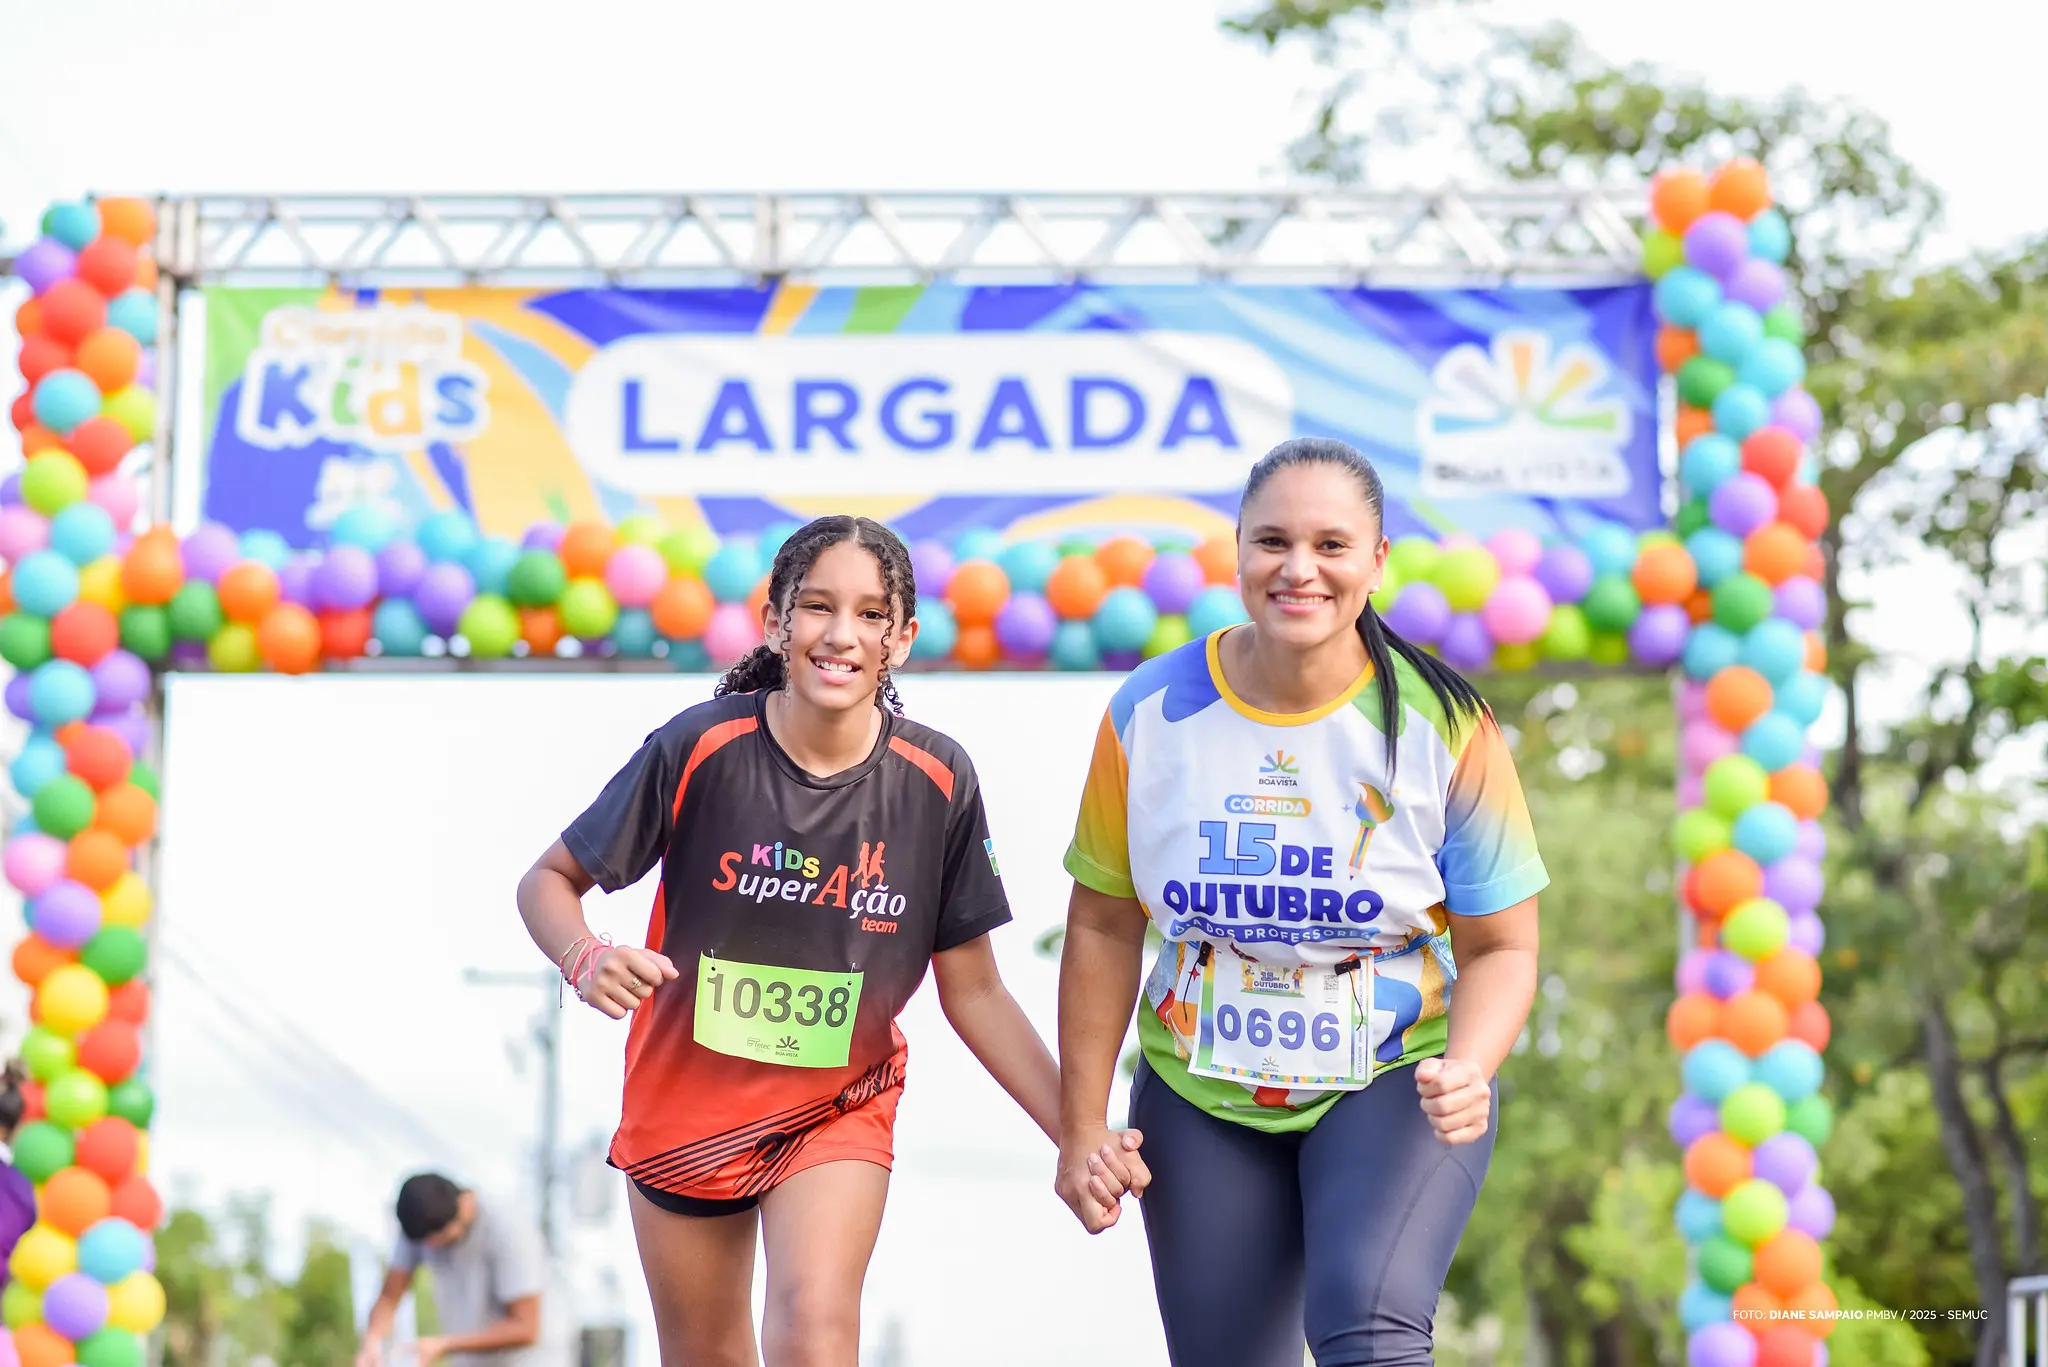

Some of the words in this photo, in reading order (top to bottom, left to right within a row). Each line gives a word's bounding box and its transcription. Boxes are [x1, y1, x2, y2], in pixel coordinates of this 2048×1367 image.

[257, 357, 476, 437] Kids
[621, 376, 1240, 453] LARGADA
[1258, 778, 1276, 787] BOA
[1276, 779, 1298, 787] VISTA
[1229, 797, 1307, 815] CORRIDA
[1199, 820, 1277, 876] 15
[1280, 844, 1333, 878] DE
[712, 851, 906, 919] SuperAção
[1163, 879, 1384, 923] OUTUBRO
[861, 916, 897, 933] team
[1206, 923, 1236, 939] DOS
[1244, 928, 1371, 943] PROFESSORES
[707, 973, 850, 1028] 10338
[1253, 980, 1290, 990] OUTUBRO
[1217, 1004, 1341, 1051] 0696
